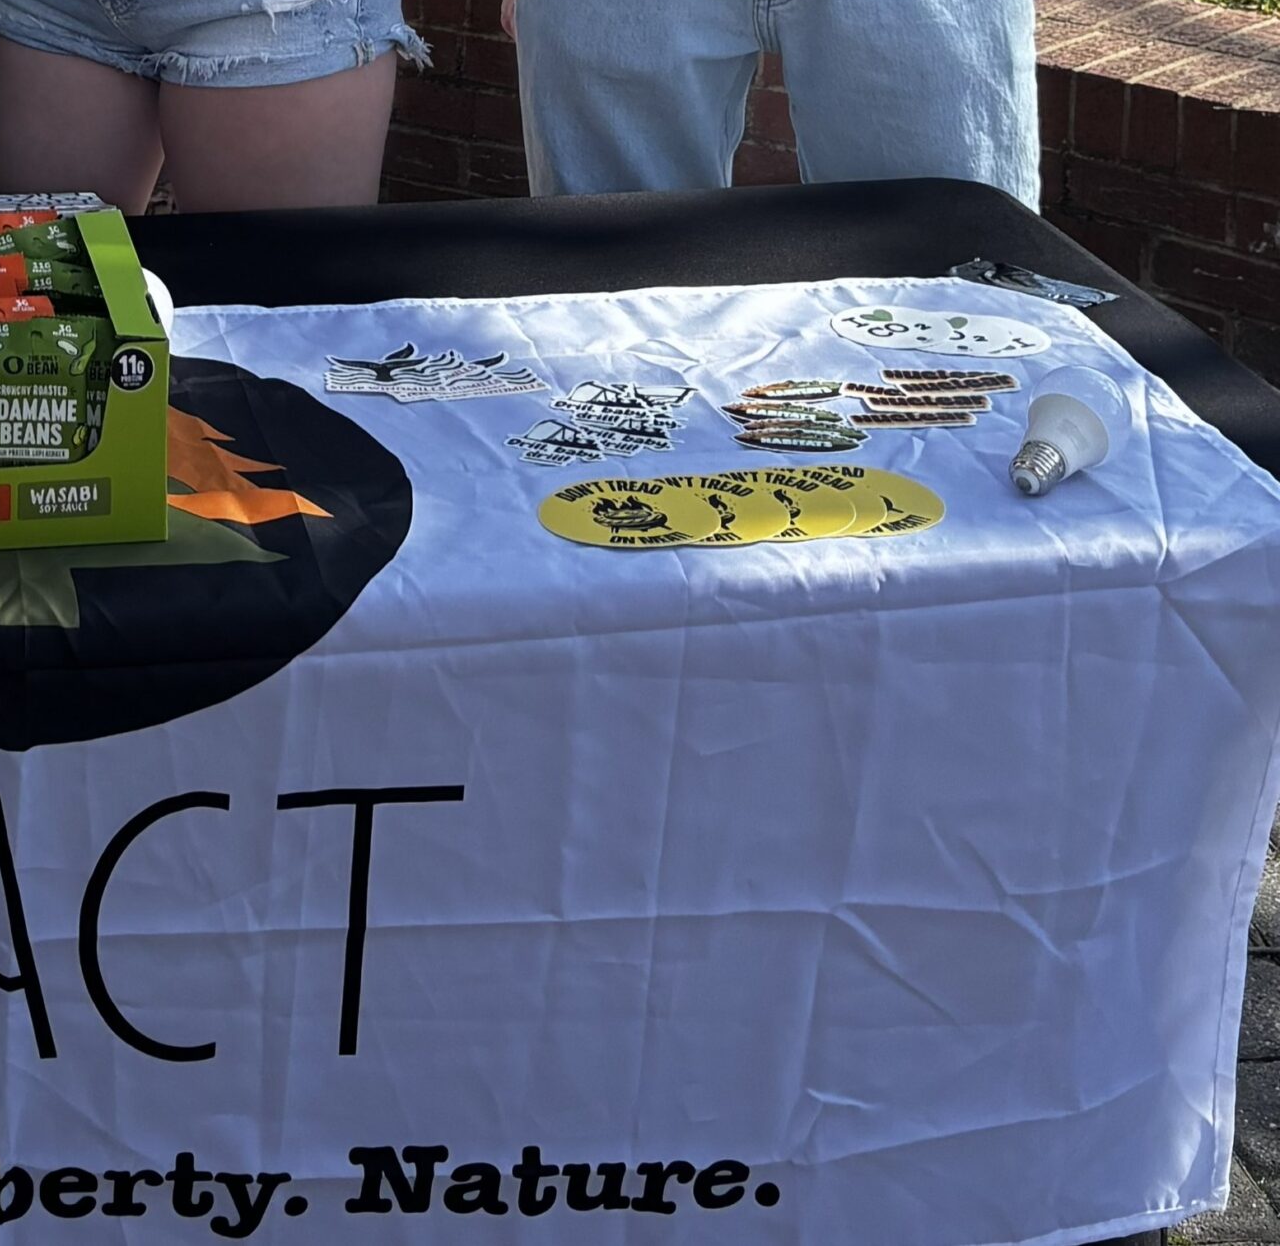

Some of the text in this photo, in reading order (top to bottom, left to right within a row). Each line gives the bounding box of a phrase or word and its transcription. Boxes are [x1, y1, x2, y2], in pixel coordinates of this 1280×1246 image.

[27, 362, 59, 375] BEAN
[89, 368, 111, 381] BEA
[119, 354, 144, 375] 11G
[33, 384, 68, 396] ROASTED
[0, 422, 63, 446] BEANS
[760, 437, 833, 448] HABITATS
[554, 479, 663, 503] DON'T TREAD
[700, 477, 754, 497] TREAD
[764, 471, 820, 492] TREAD
[30, 484, 98, 504] WASABI
[39, 502, 88, 514] SOY SAUCE
[609, 536, 636, 544] ON
[345, 1144, 781, 1216] Nature.
